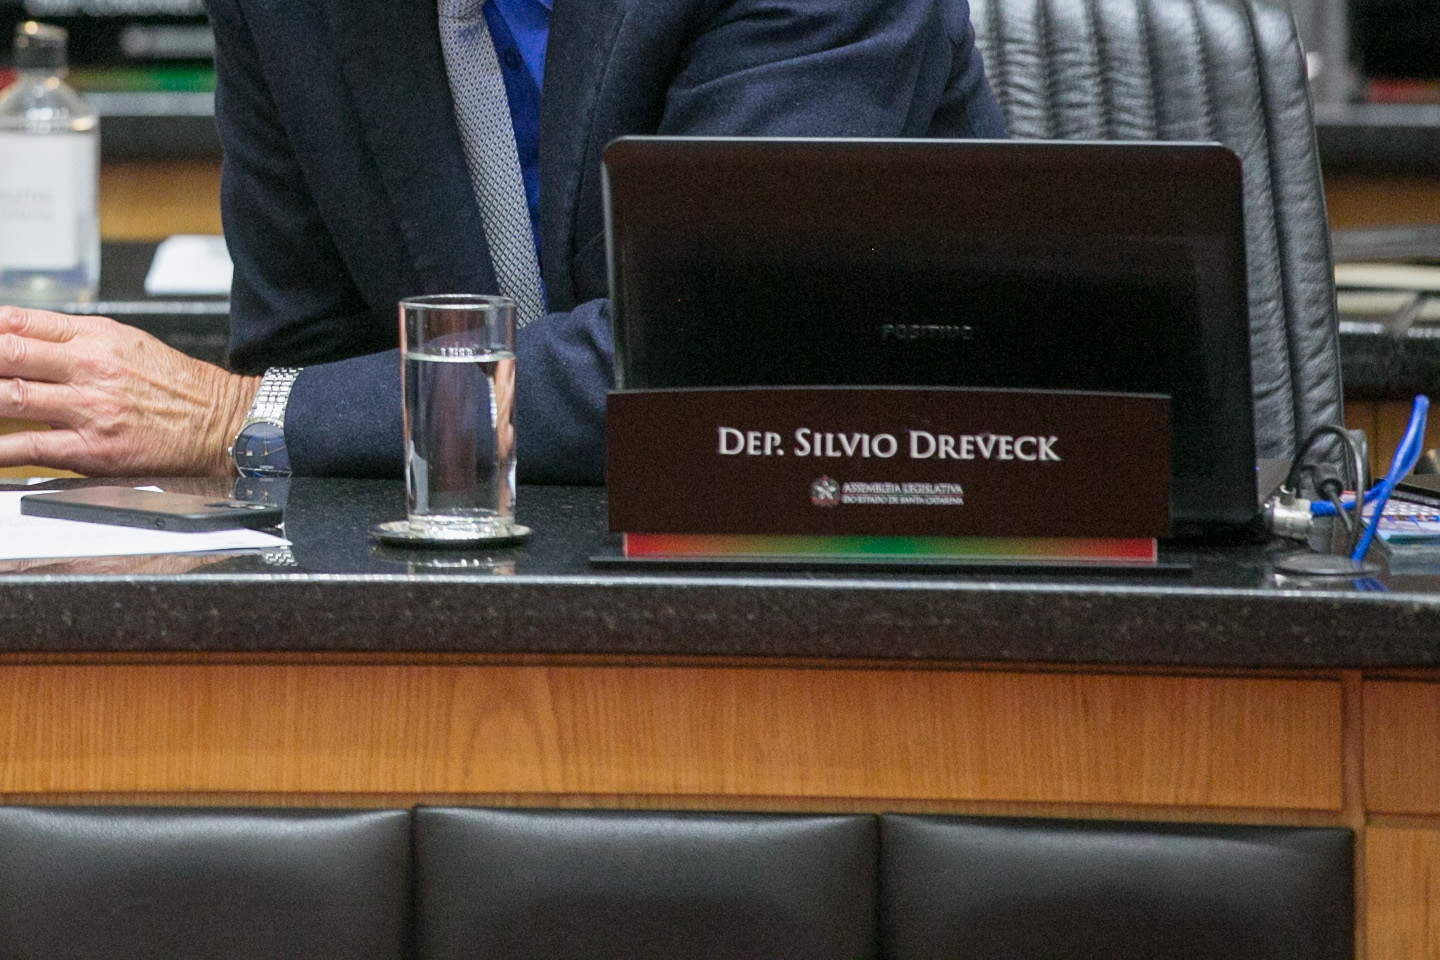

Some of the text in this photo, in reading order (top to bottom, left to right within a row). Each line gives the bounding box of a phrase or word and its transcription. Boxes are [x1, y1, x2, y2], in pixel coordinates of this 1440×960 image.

[718, 427, 1061, 461] DEP. SILVIO DREVECK
[842, 482, 963, 494] ASSEMBLEIA LEGISLATIVA
